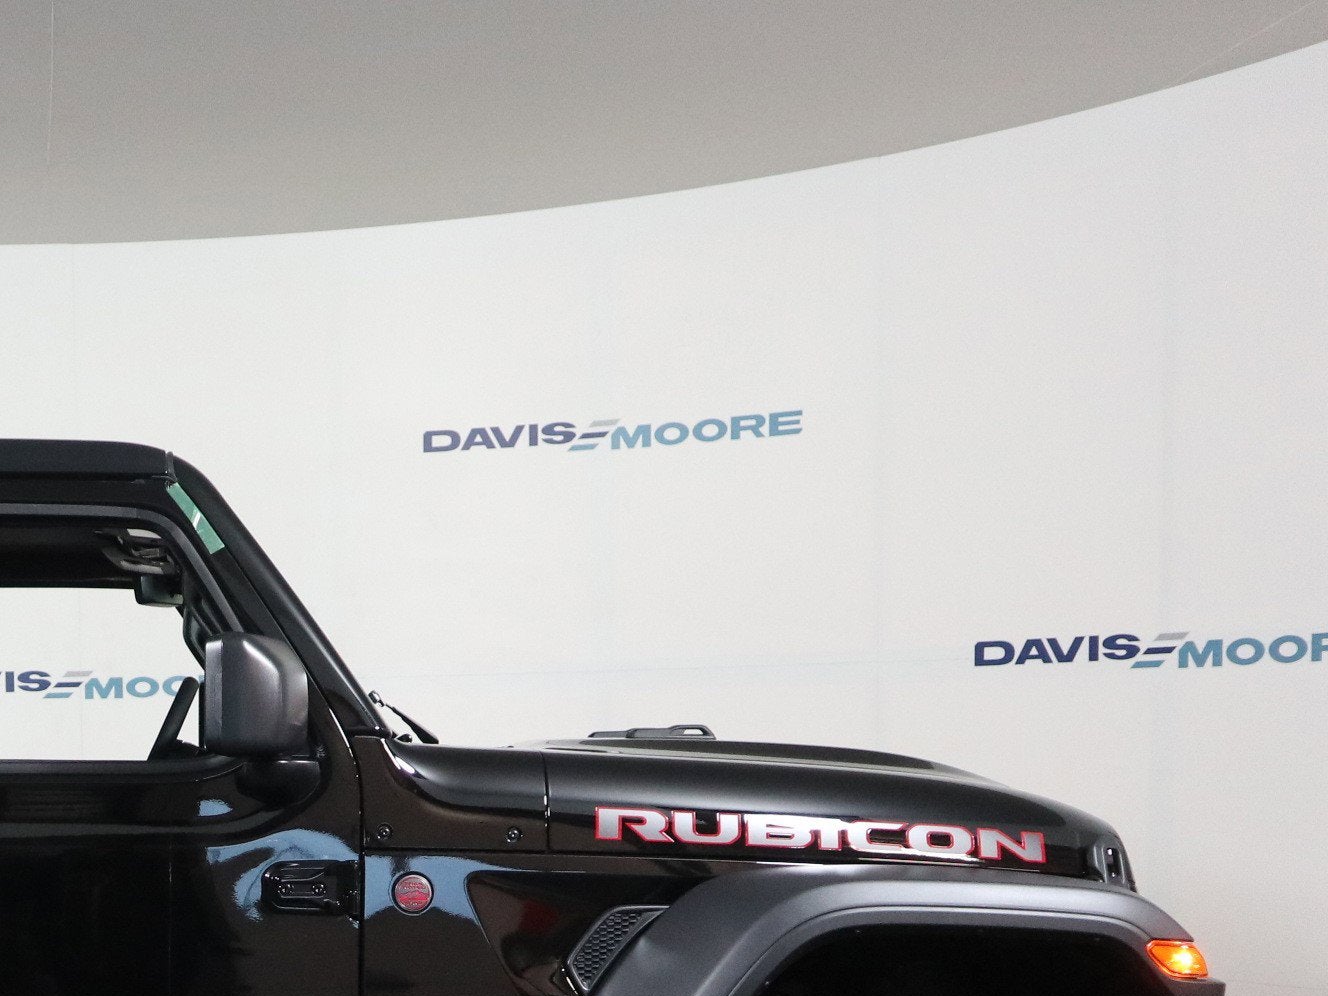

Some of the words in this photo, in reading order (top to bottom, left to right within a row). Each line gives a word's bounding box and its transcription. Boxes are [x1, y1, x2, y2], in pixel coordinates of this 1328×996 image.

[423, 421, 576, 453] DAVIS
[610, 410, 803, 450] MOORE
[974, 634, 1140, 666] DAVIS
[84, 674, 205, 700] MOO
[595, 807, 1047, 863] RUBICON
